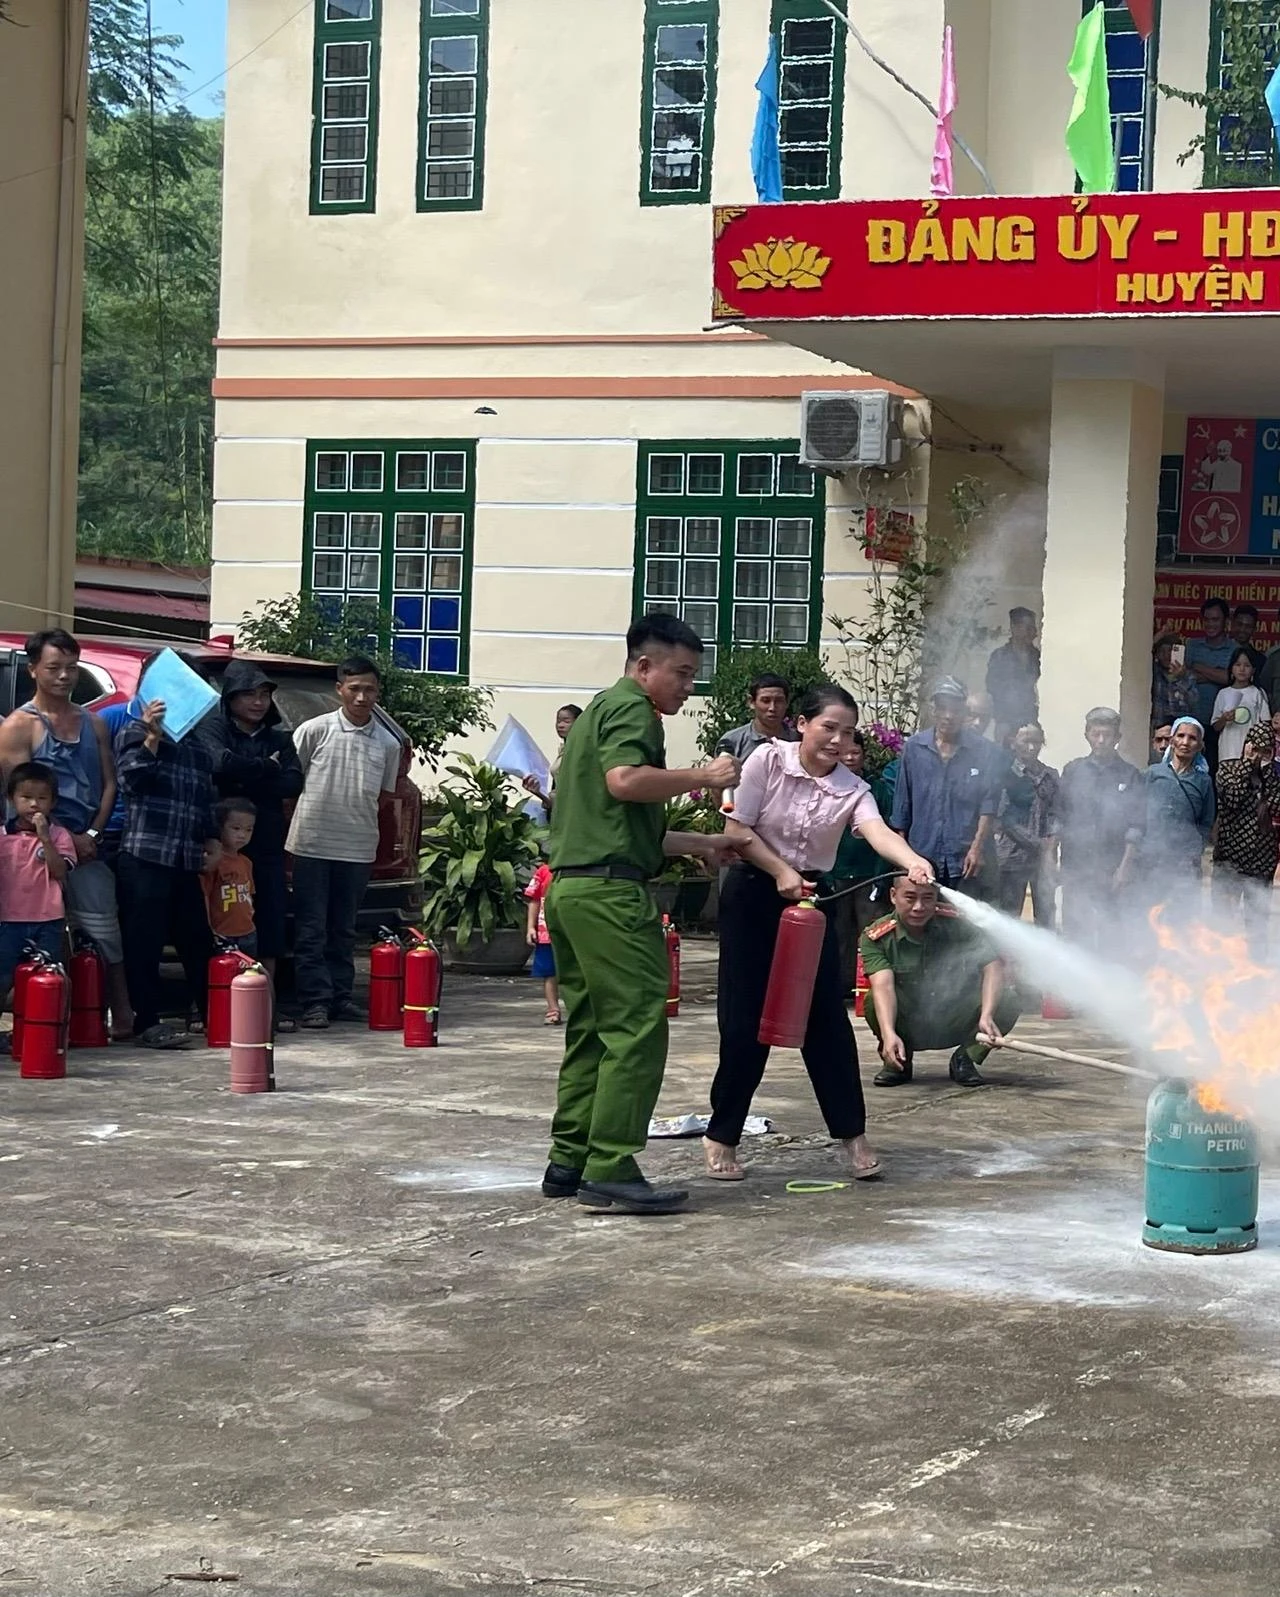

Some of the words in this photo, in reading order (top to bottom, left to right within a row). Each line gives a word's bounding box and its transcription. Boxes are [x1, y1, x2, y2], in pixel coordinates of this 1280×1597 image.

[865, 200, 1036, 263] ĐẢNG
[1057, 197, 1139, 260] ỦY
[1115, 264, 1265, 308] HUYỆN
[1173, 581, 1200, 603] VIỆC
[1204, 585, 1232, 601] THEO
[1236, 580, 1265, 601] HIẾN
